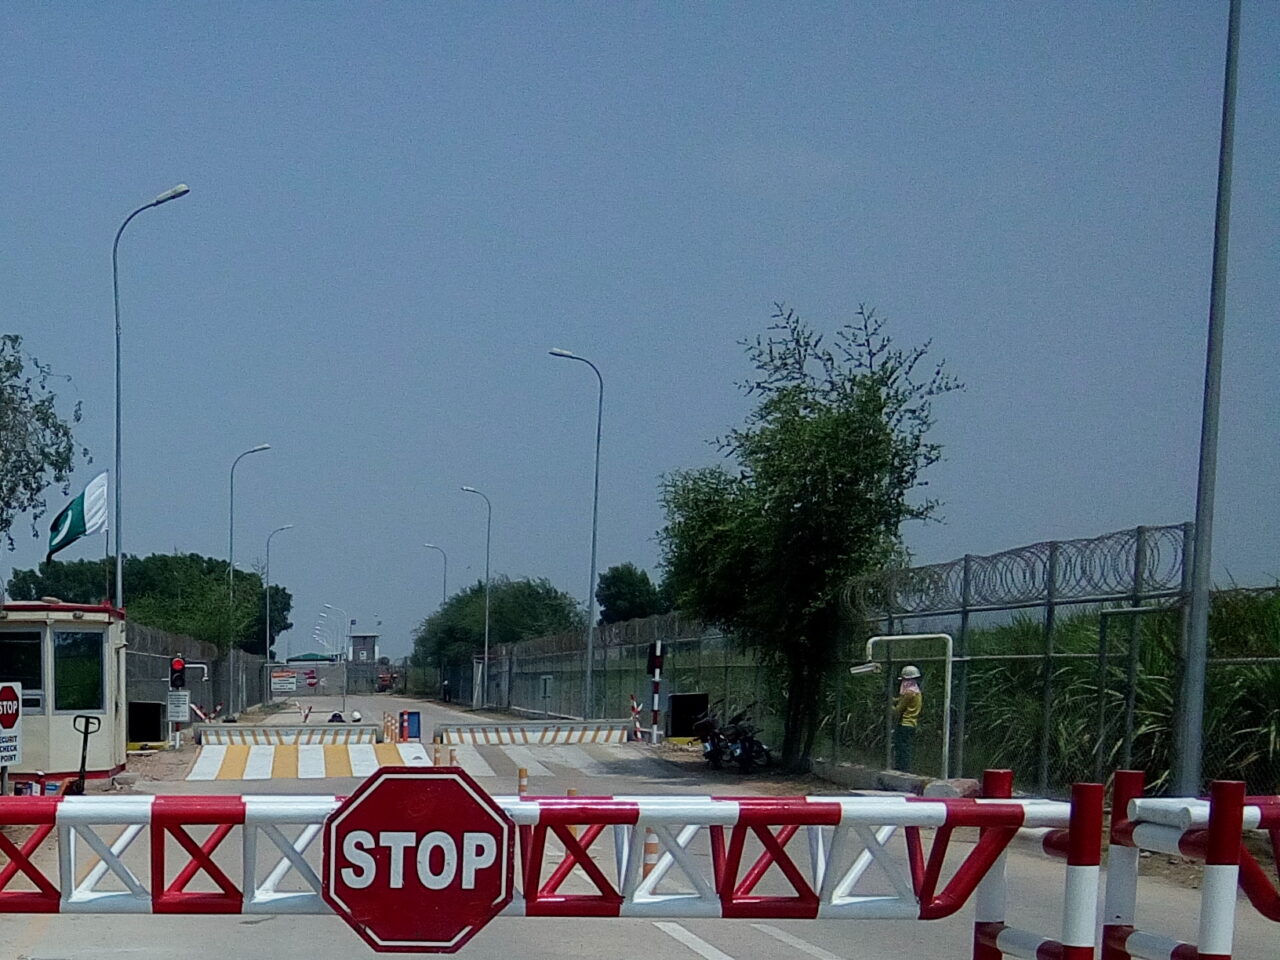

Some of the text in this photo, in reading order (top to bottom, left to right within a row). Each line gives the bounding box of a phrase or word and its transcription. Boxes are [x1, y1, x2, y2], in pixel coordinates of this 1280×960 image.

[0, 745, 17, 753] CHECK
[0, 754, 16, 762] POINT
[340, 830, 497, 890] STOP
